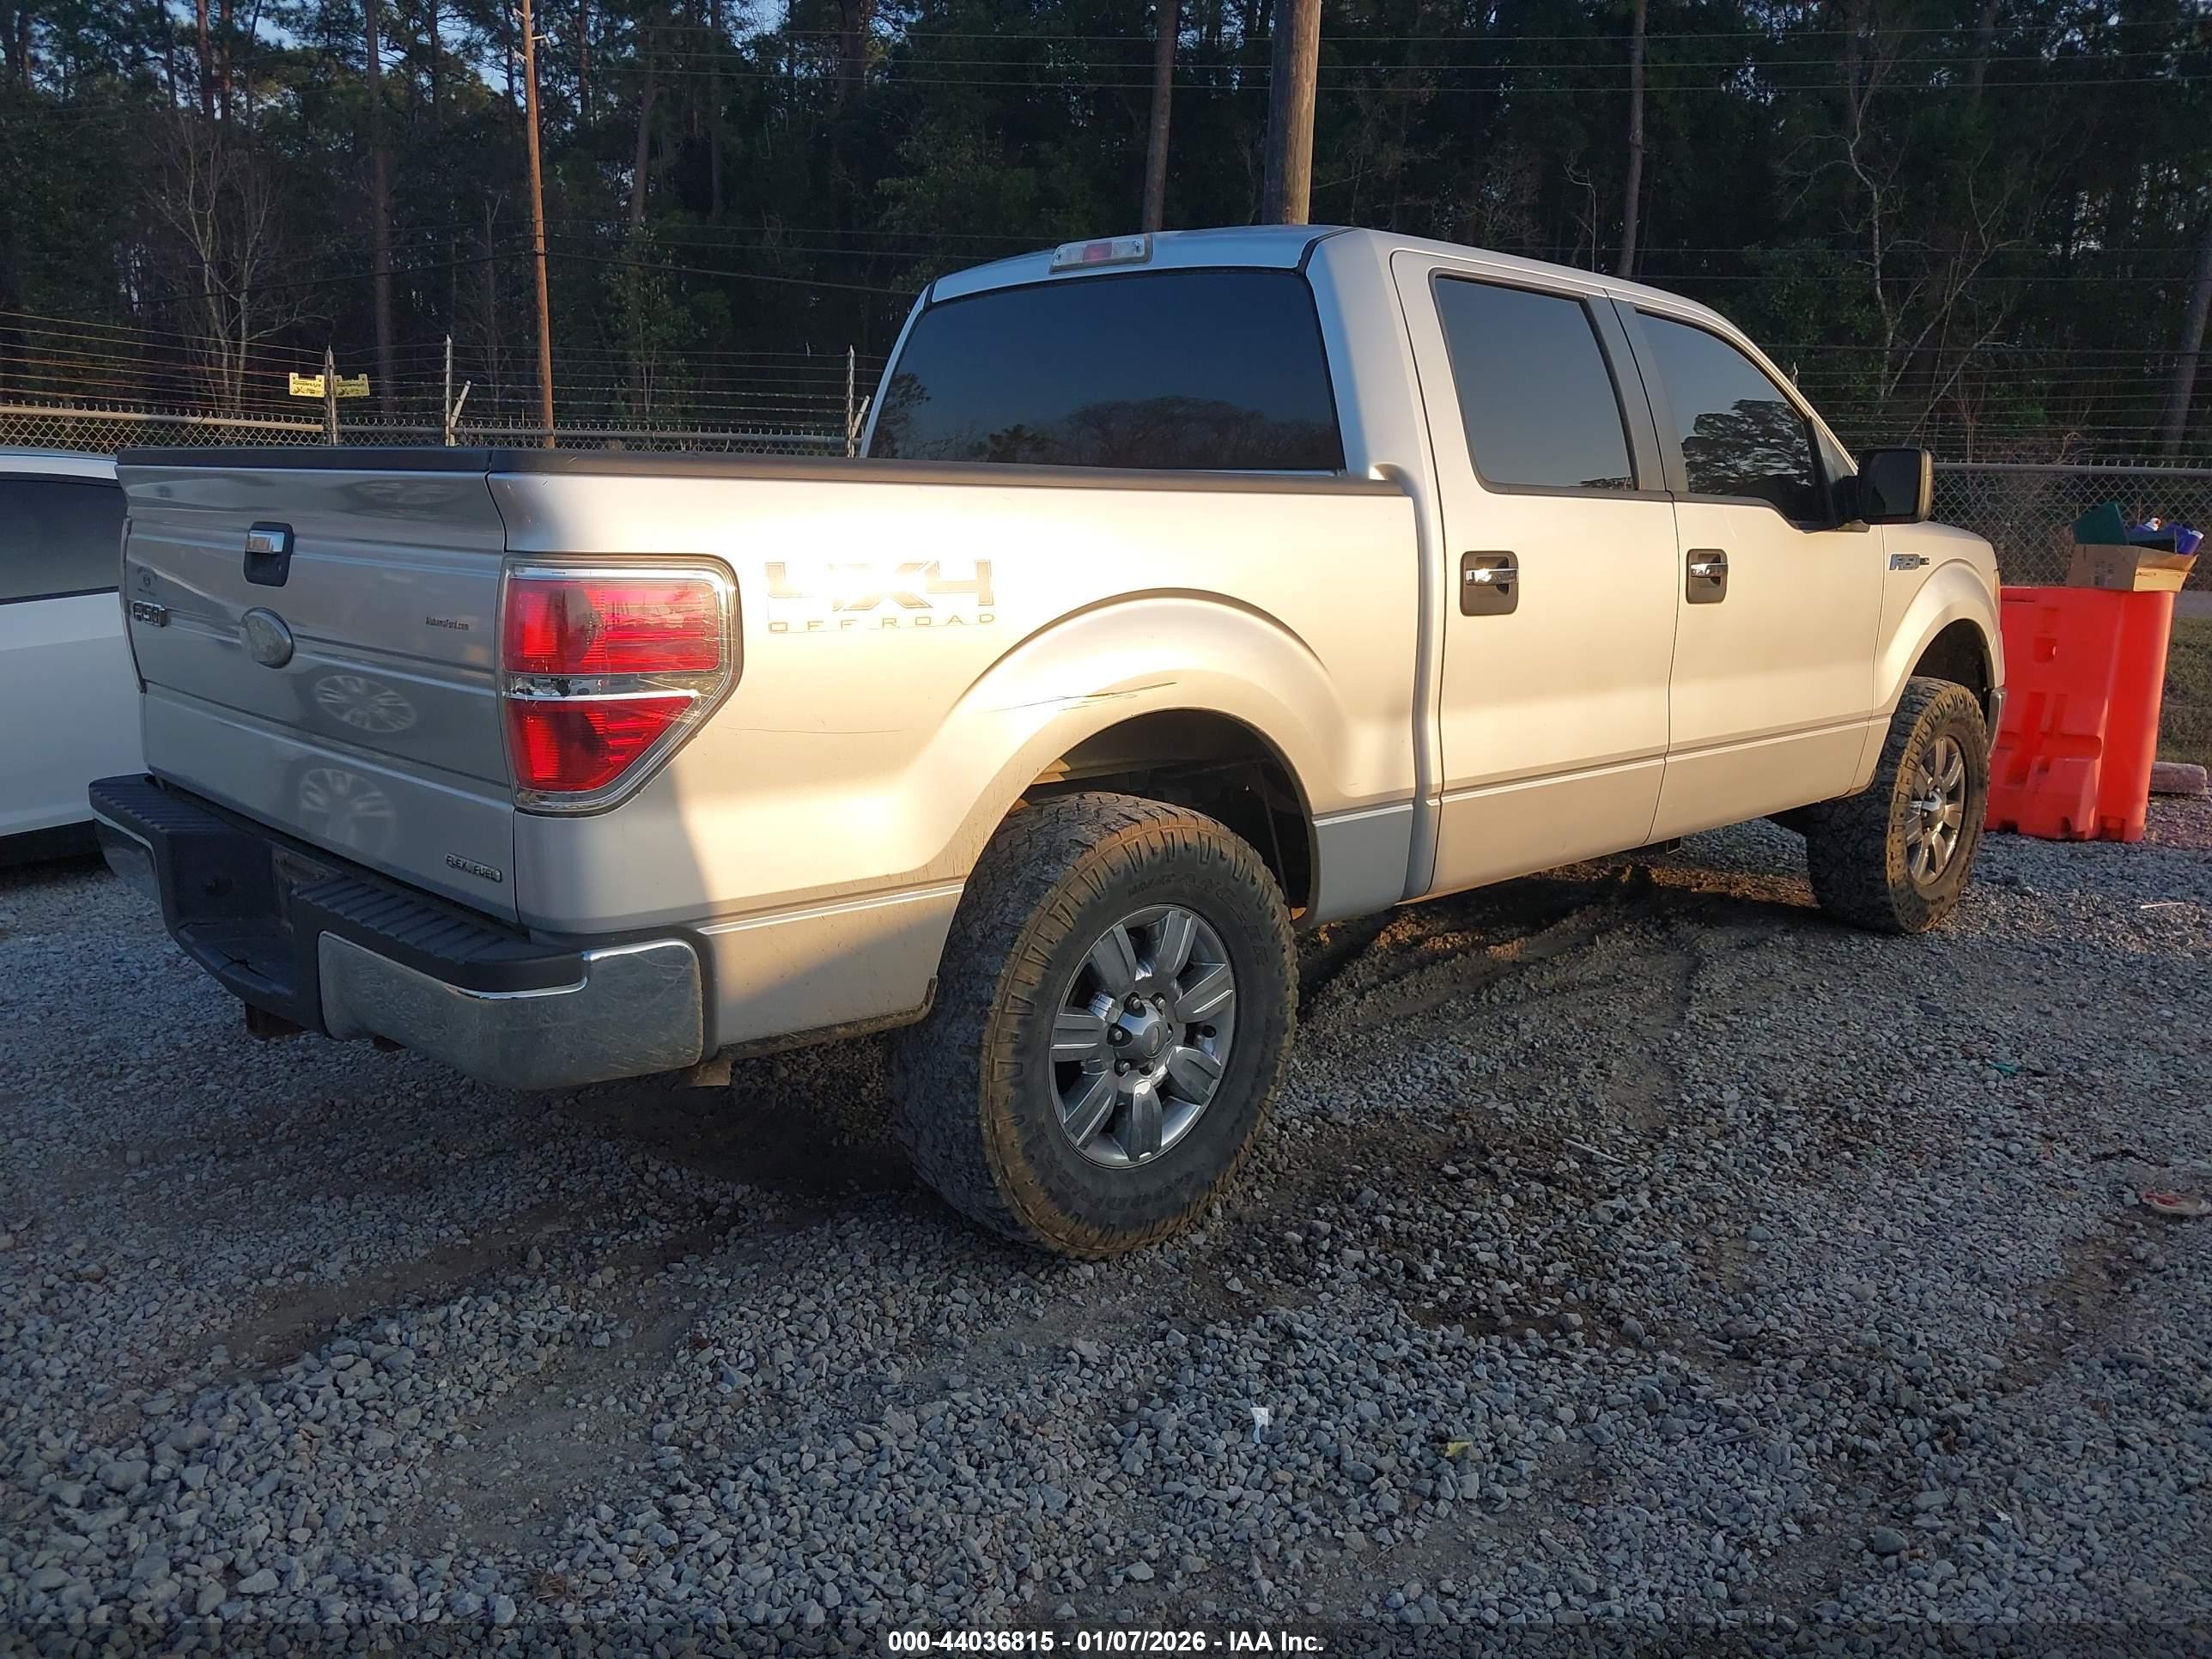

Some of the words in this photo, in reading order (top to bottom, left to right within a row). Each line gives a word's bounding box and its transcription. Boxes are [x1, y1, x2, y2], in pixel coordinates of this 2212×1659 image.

[769, 619, 858, 633] OFF
[882, 614, 995, 628] ROAD
[446, 854, 468, 871] FLEX
